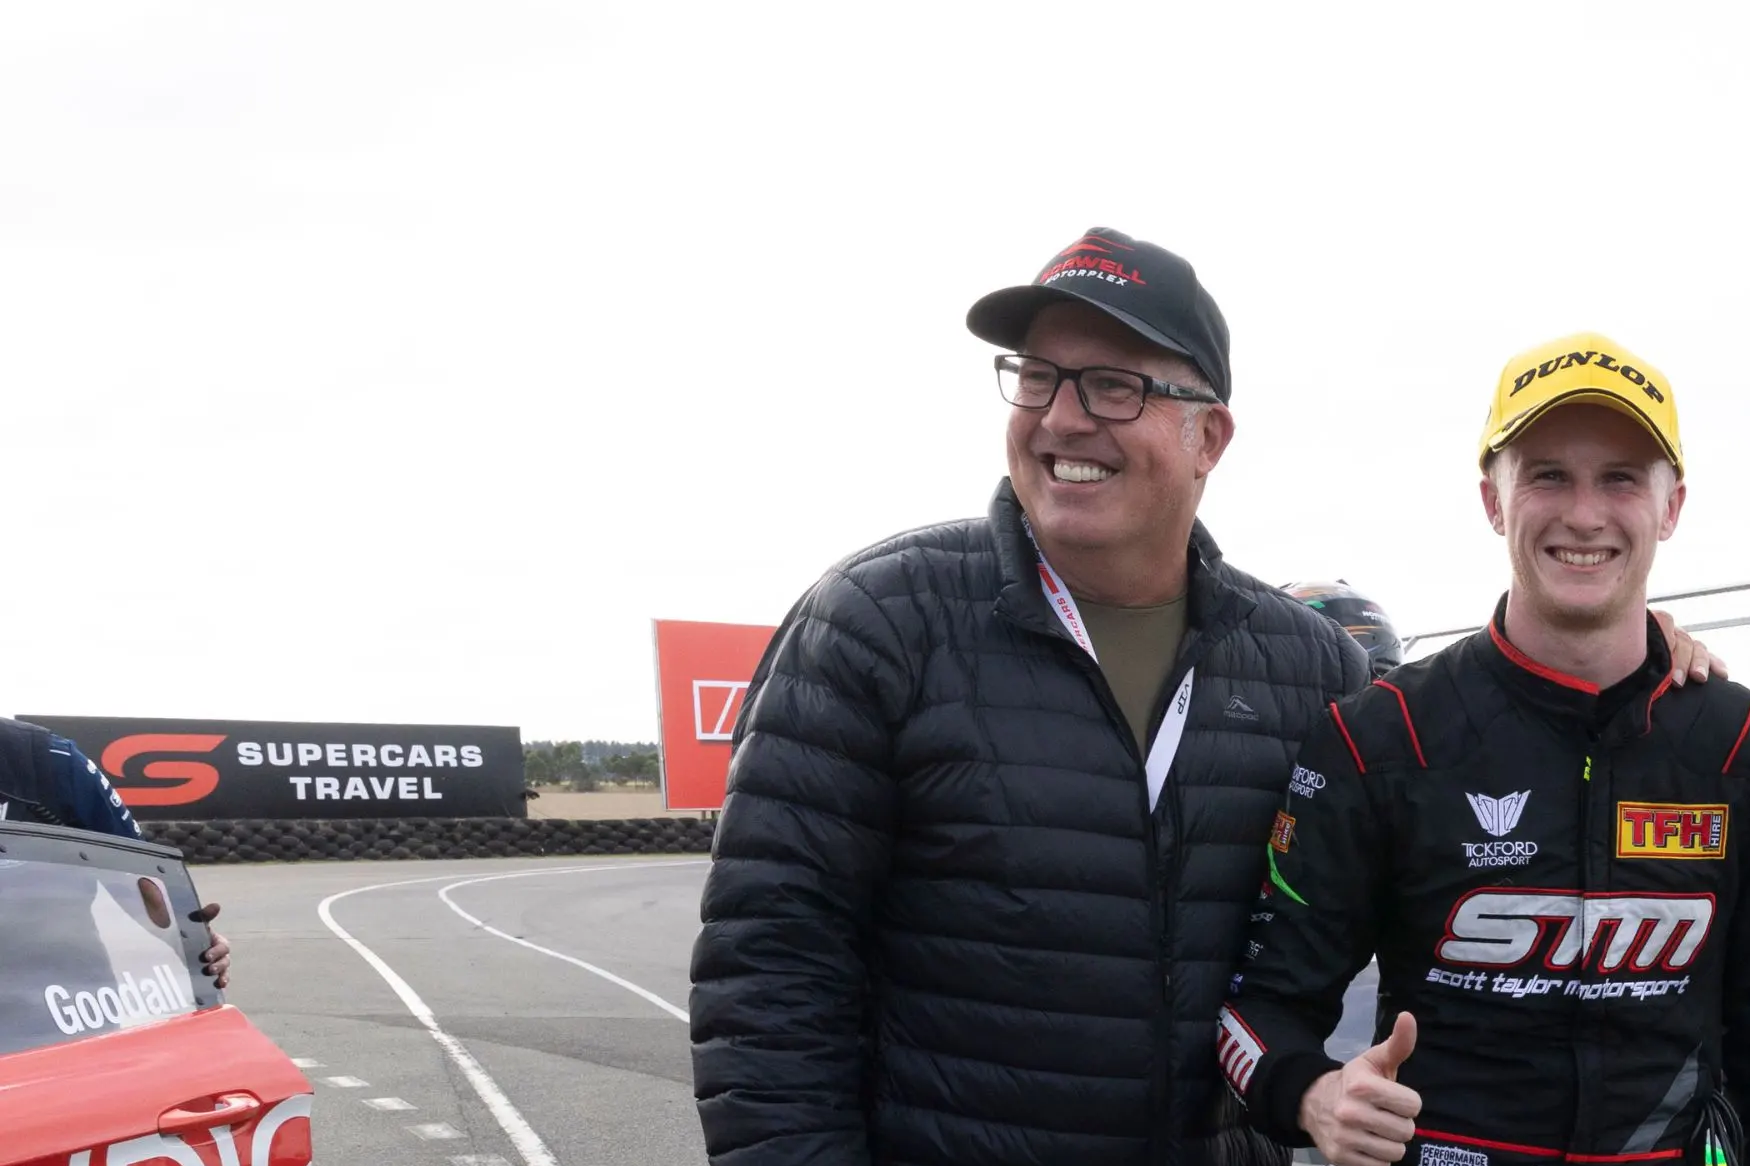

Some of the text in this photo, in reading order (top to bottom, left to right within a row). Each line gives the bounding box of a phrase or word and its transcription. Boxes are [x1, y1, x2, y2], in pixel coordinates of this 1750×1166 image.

[1509, 351, 1665, 404] DUNLOP
[1177, 683, 1190, 715] VIP
[237, 742, 484, 768] SUPERCARS
[289, 776, 443, 801] TRAVEL
[1624, 809, 1714, 848] TFH
[1710, 815, 1721, 847] HIRE
[1461, 841, 1538, 857] TICKFORD
[1468, 856, 1532, 868] AUTOSPORT
[1434, 886, 1716, 974] STM
[1426, 966, 1488, 992] scott
[1492, 973, 1563, 998] taylor
[44, 963, 189, 1035] Goodall
[1423, 1146, 1486, 1166] PERFORMANCE
